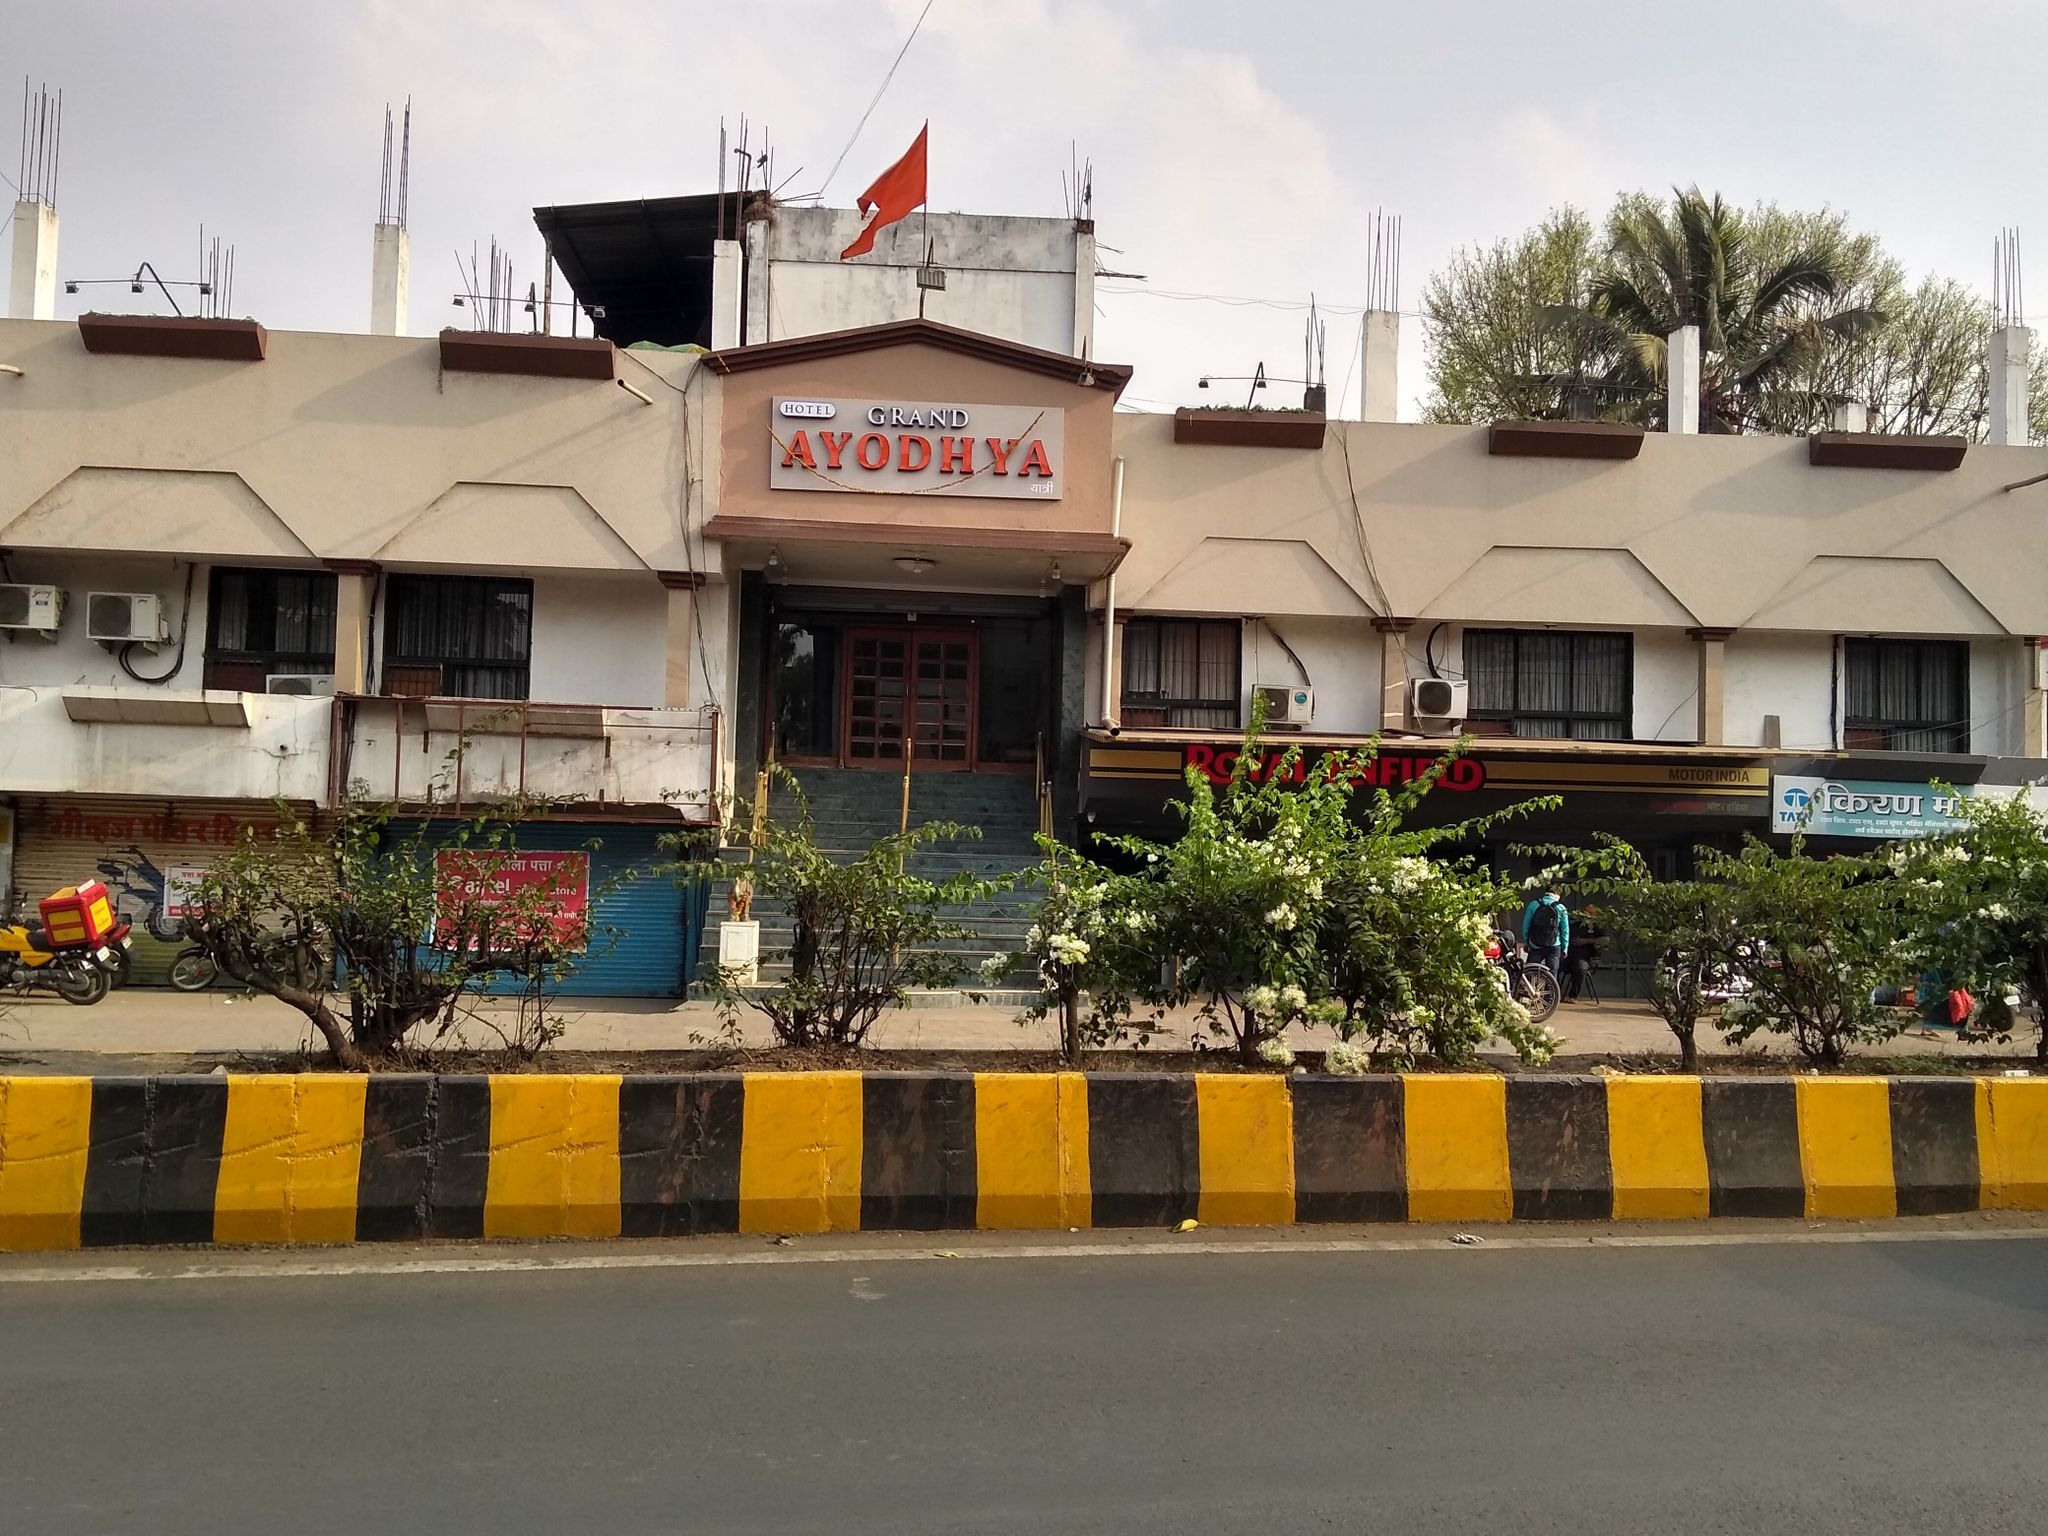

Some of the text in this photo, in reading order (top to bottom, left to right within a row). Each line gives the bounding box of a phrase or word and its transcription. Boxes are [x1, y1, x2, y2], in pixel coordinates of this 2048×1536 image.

[784, 403, 832, 416] HOTEL
[867, 406, 970, 428] GRAND
[781, 430, 1054, 477] AYODHYA
[1030, 481, 1053, 494] यात्री
[1669, 768, 1750, 782] MOTOR INDIA
[1822, 783, 1924, 817] किरण
[1779, 811, 1812, 823] TATA
